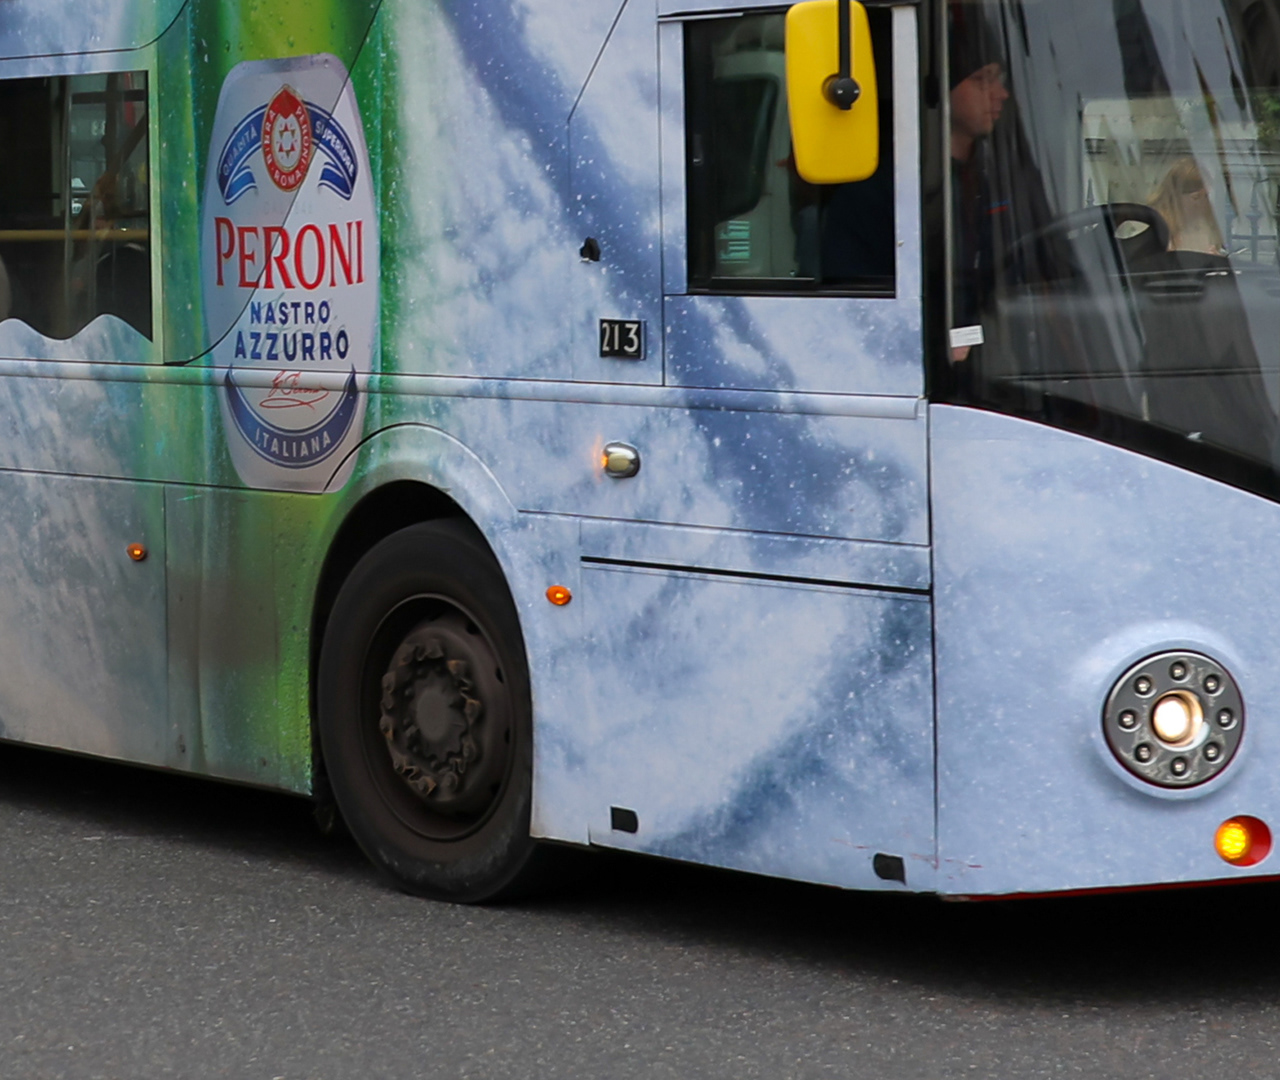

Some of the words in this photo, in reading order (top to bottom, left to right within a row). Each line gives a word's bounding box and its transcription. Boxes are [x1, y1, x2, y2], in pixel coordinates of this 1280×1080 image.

[214, 217, 365, 290] PERONI
[251, 300, 330, 325] NASTRO
[235, 330, 349, 362] AZZURRO
[602, 322, 639, 353] 213
[255, 428, 331, 458] ITALIANA
